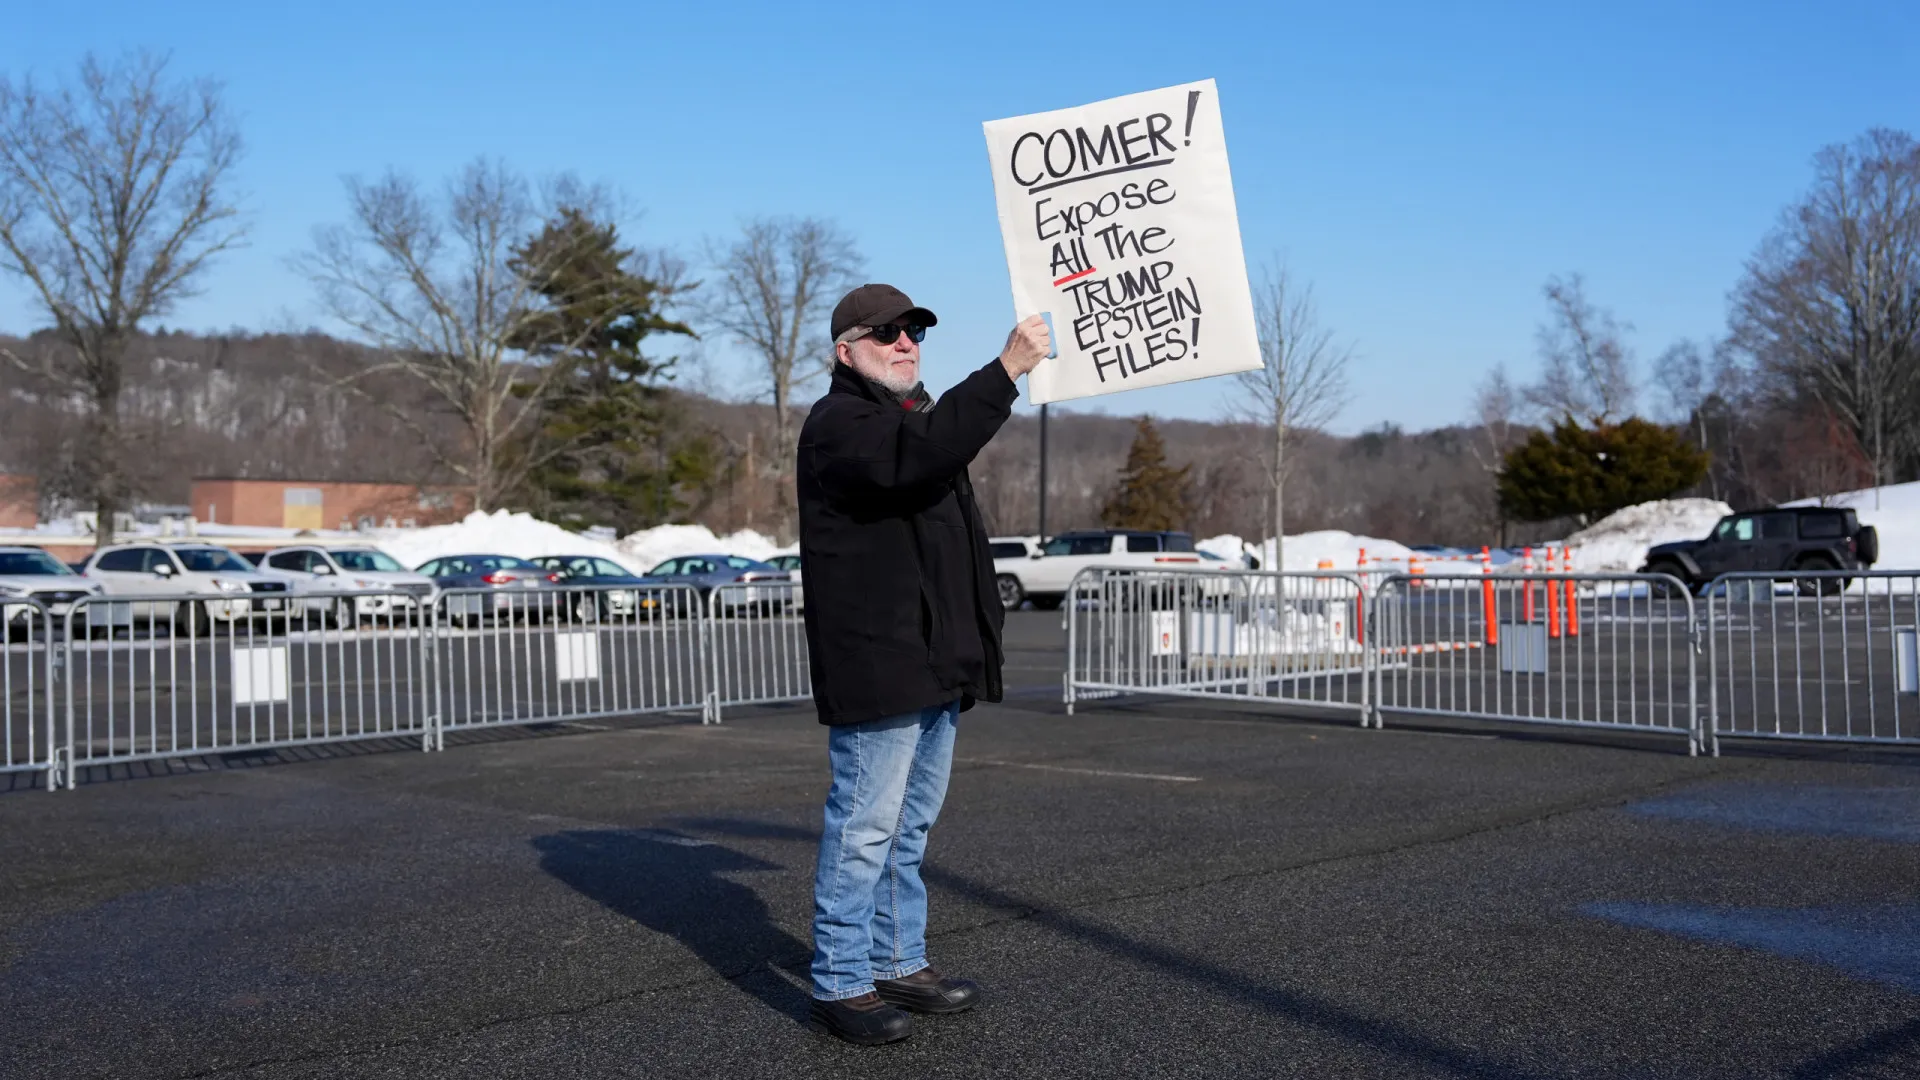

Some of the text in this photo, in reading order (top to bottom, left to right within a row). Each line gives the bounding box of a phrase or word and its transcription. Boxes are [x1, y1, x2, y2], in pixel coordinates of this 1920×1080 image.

[1011, 91, 1202, 186] COMER!
[1036, 178, 1176, 240] Expose
[1050, 223, 1175, 276] All The
[1062, 261, 1173, 315] TRUMP
[1073, 277, 1201, 350] EPSTEIN
[1092, 318, 1200, 382] FILES!
